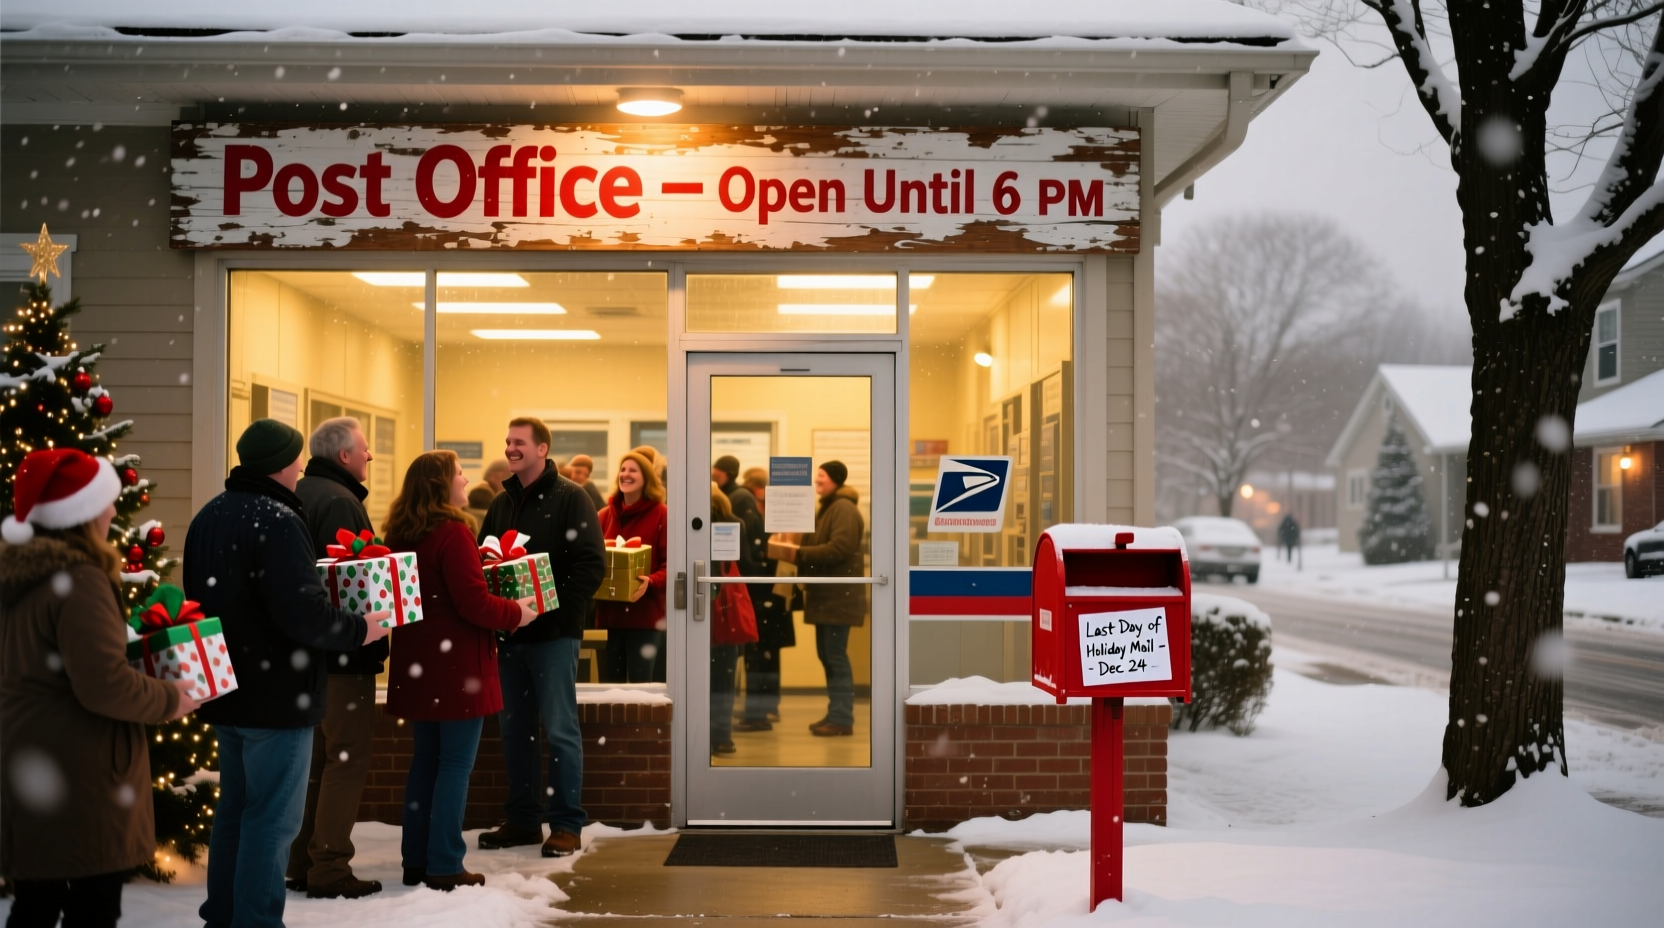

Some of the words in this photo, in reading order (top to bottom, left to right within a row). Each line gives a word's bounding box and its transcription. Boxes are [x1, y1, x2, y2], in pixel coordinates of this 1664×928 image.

[223, 145, 391, 217] Post
[416, 144, 643, 218] Office
[718, 166, 846, 225] Open
[864, 168, 974, 214] Until
[992, 171, 1021, 215] 6
[1038, 179, 1104, 217] PM
[1086, 621, 1115, 638] Last
[1118, 619, 1143, 638] Day
[1148, 616, 1162, 634] of
[1086, 642, 1126, 660] Holiday
[1130, 638, 1154, 654] Mail
[1098, 661, 1124, 676] Dec
[1128, 659, 1147, 672] 24
